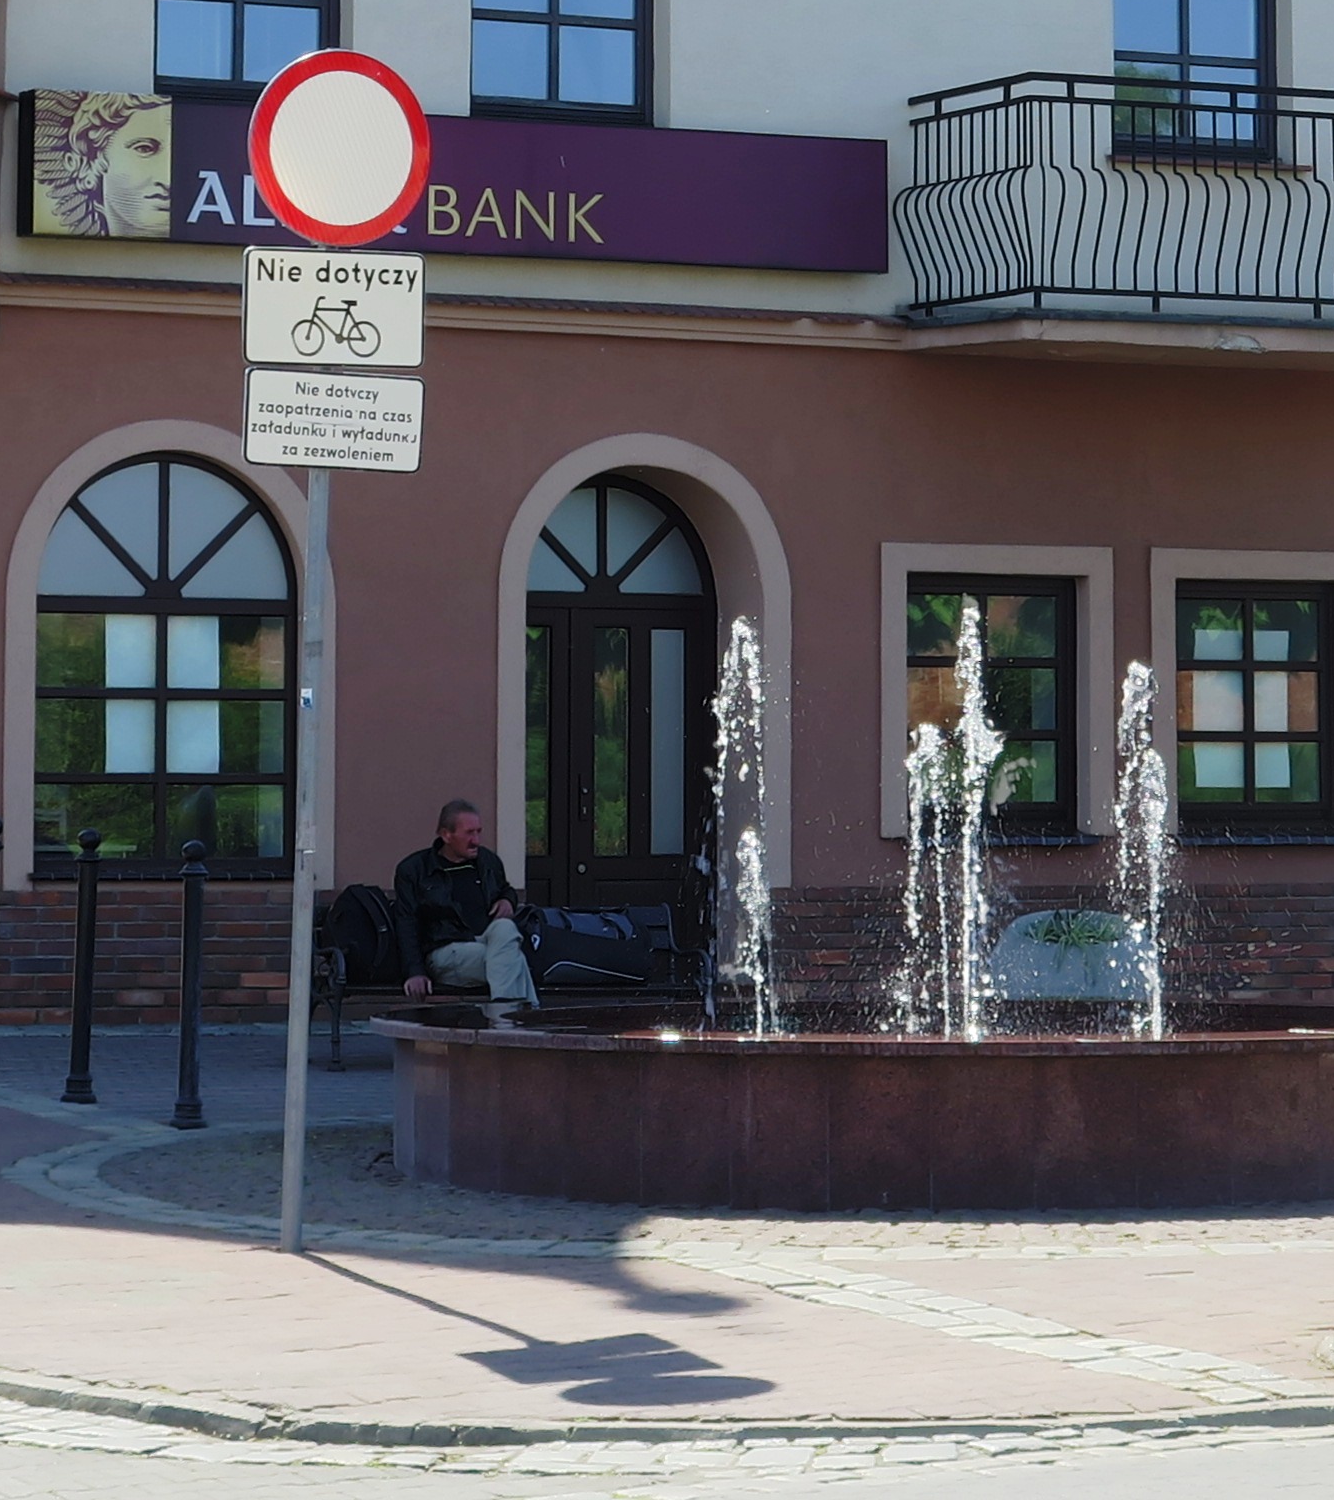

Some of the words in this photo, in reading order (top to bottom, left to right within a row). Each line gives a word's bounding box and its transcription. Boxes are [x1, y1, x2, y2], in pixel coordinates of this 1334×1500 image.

[428, 184, 605, 244] BANK
[256, 258, 303, 283] Nie
[315, 260, 419, 293] dotyczy
[295, 381, 320, 396] Nie
[325, 384, 380, 404] dotyczy
[258, 402, 354, 419] zaopatrzenia
[358, 410, 377, 421] na
[382, 411, 413, 423] czas
[251, 420, 327, 438] załadunku
[332, 424, 337, 439] i
[282, 444, 298, 456] za
[304, 446, 395, 463] zezwoleniem
